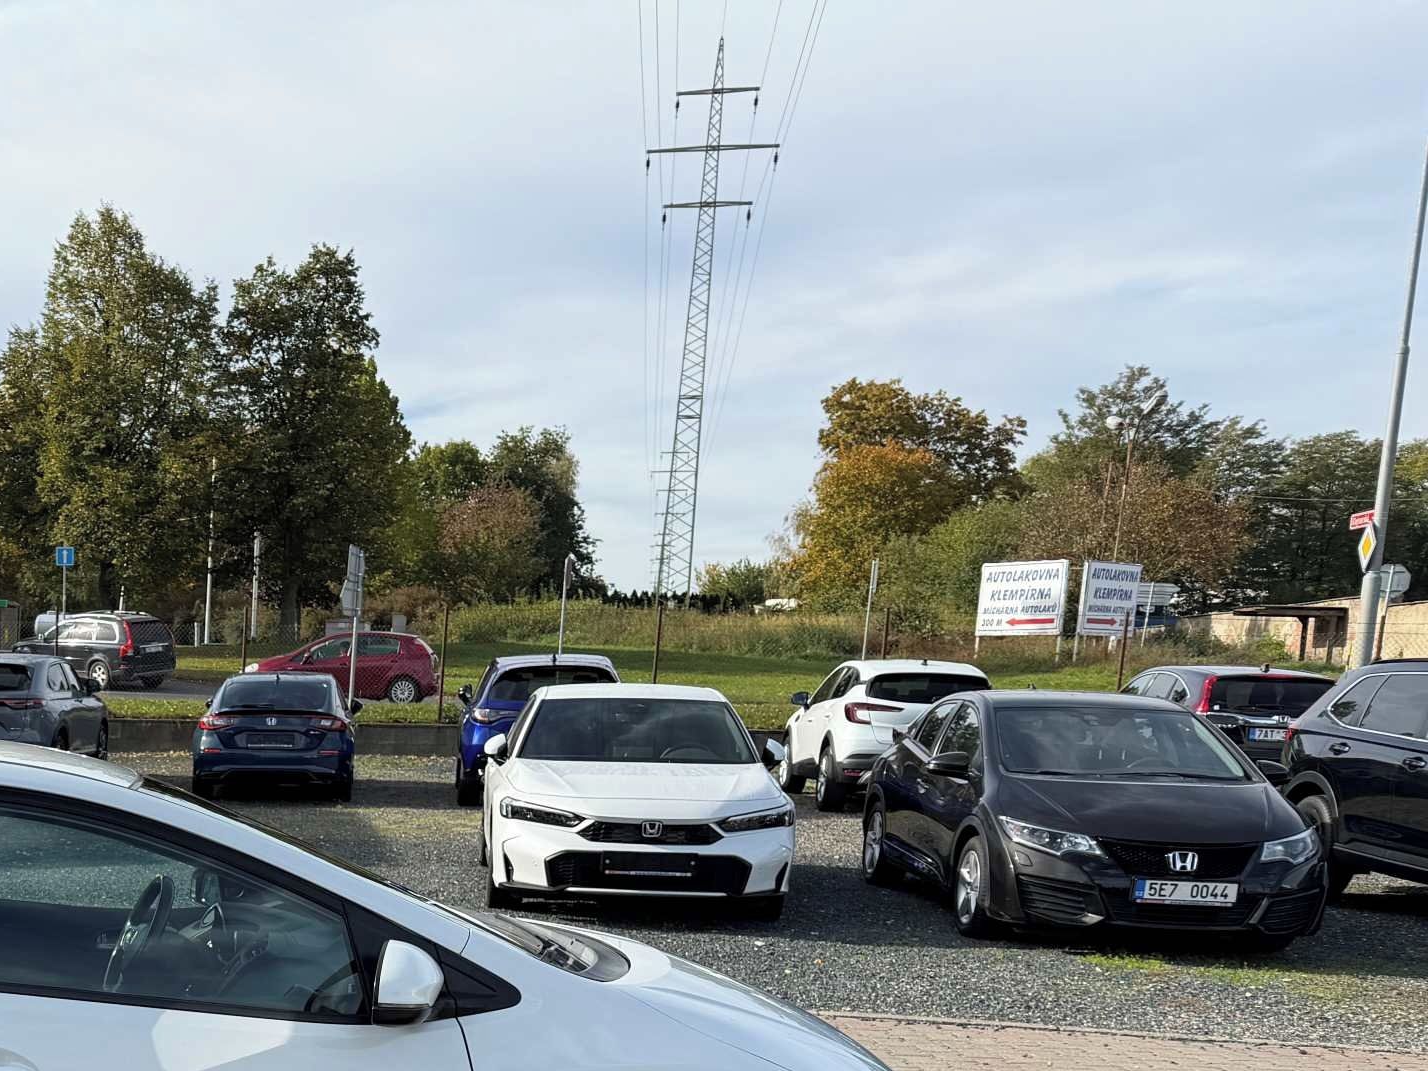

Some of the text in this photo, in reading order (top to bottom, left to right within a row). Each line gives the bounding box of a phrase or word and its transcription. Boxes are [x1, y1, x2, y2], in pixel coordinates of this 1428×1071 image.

[986, 567, 1060, 583] AUTOLAKOVNA
[1092, 567, 1139, 583] AUTOLAKOVNA
[990, 585, 1052, 601] KLEMPÍRNA
[1093, 585, 1133, 601] KLEMPÍRNA
[1020, 601, 1057, 614] AUTOLAKŮ
[1257, 729, 1275, 739] 7AT
[1147, 882, 1229, 900] 5E7 0044
